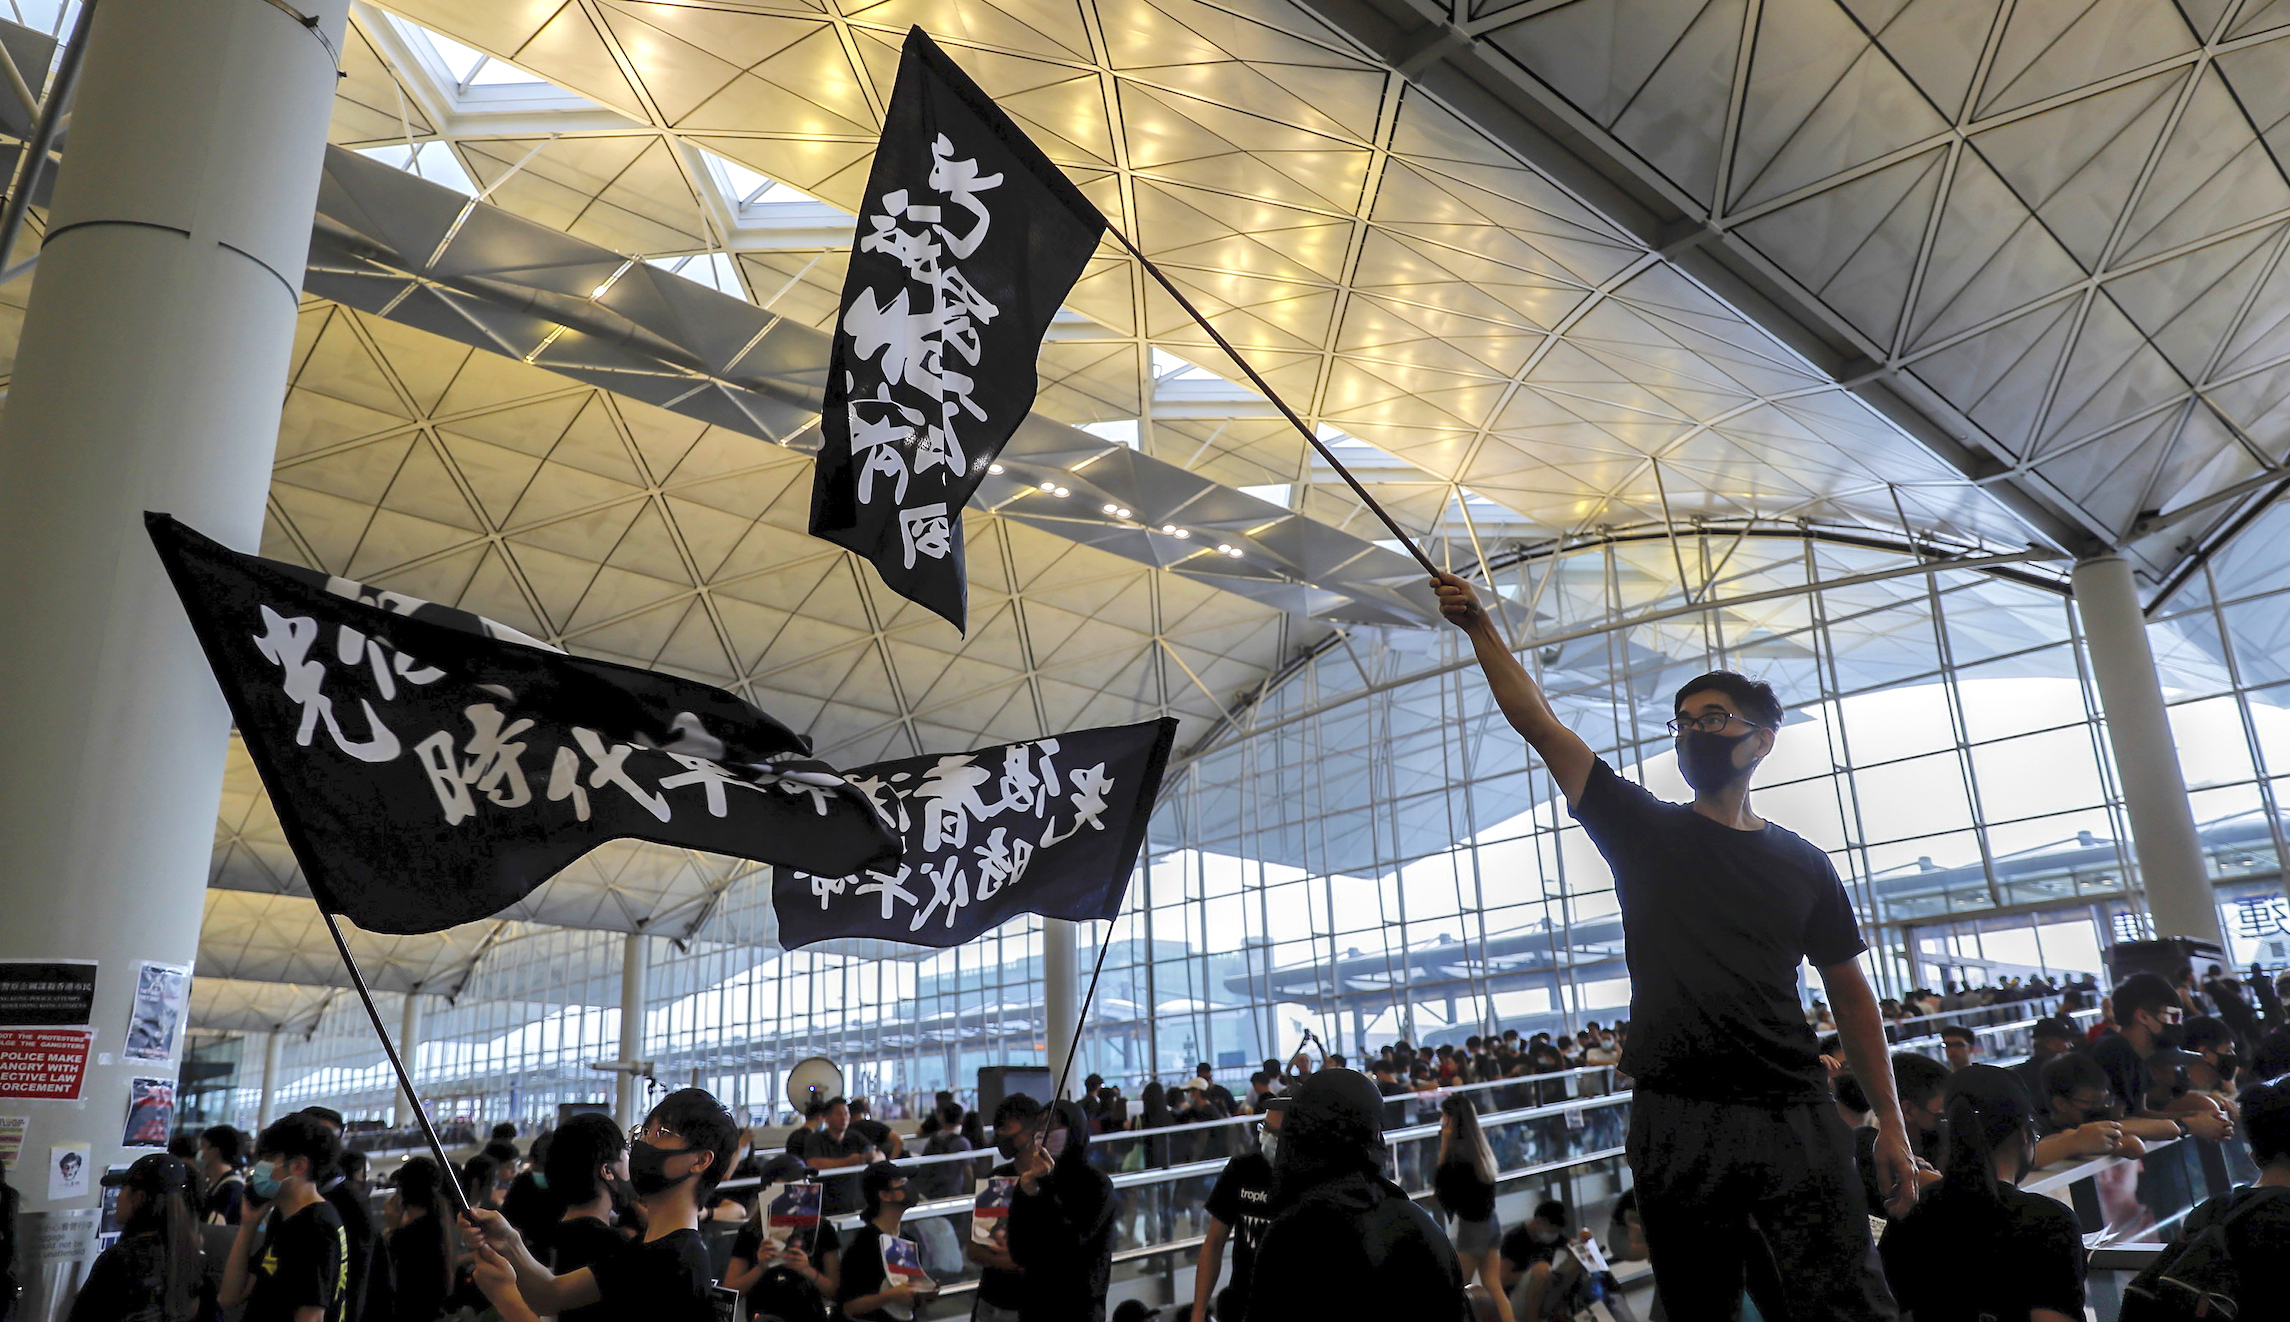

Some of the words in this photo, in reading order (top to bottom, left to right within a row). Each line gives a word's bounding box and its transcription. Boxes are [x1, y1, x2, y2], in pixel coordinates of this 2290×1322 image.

[37, 1034, 85, 1042] PROTESTERS
[40, 1042, 85, 1050] GANGSTERS
[0, 1051, 45, 1061] POLICE
[47, 1053, 83, 1063] MAKE
[0, 1062, 44, 1072] ANGRY
[47, 1064, 80, 1073] WITH
[50, 1074, 77, 1083] LAW
[0, 1082, 72, 1094] ORCEMENT
